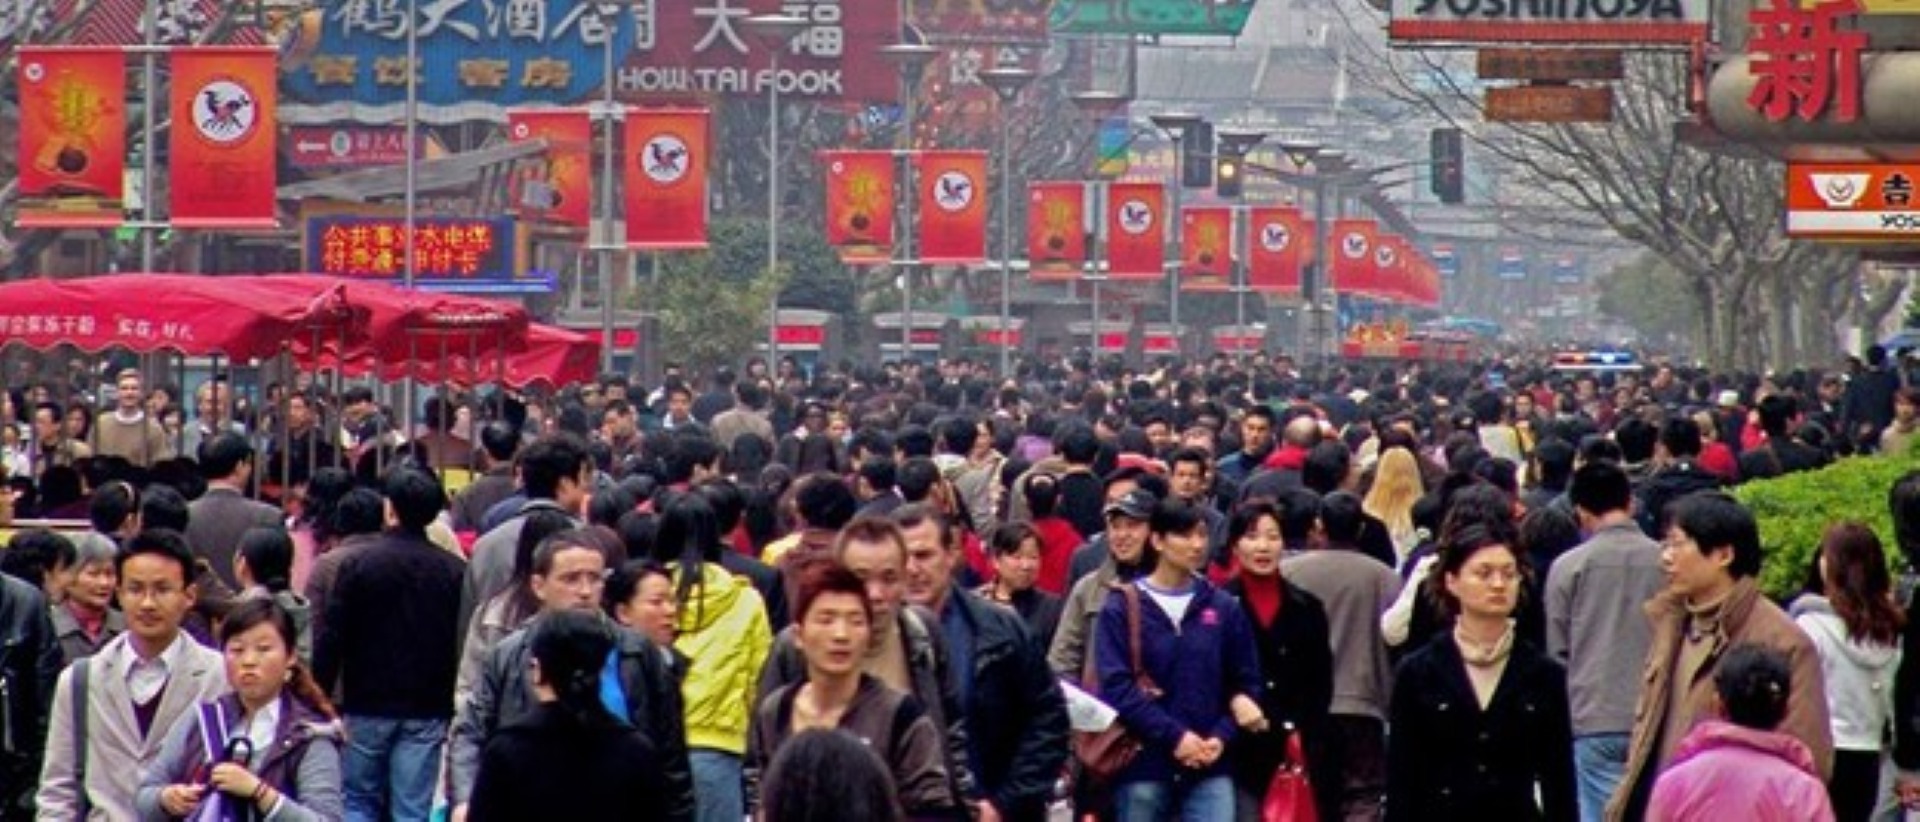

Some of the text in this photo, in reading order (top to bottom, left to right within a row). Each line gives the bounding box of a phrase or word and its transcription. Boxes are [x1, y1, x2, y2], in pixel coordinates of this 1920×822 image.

[693, 68, 747, 92] TAI
[754, 69, 843, 93] FOOK
[1746, 0, 1868, 122] 新
